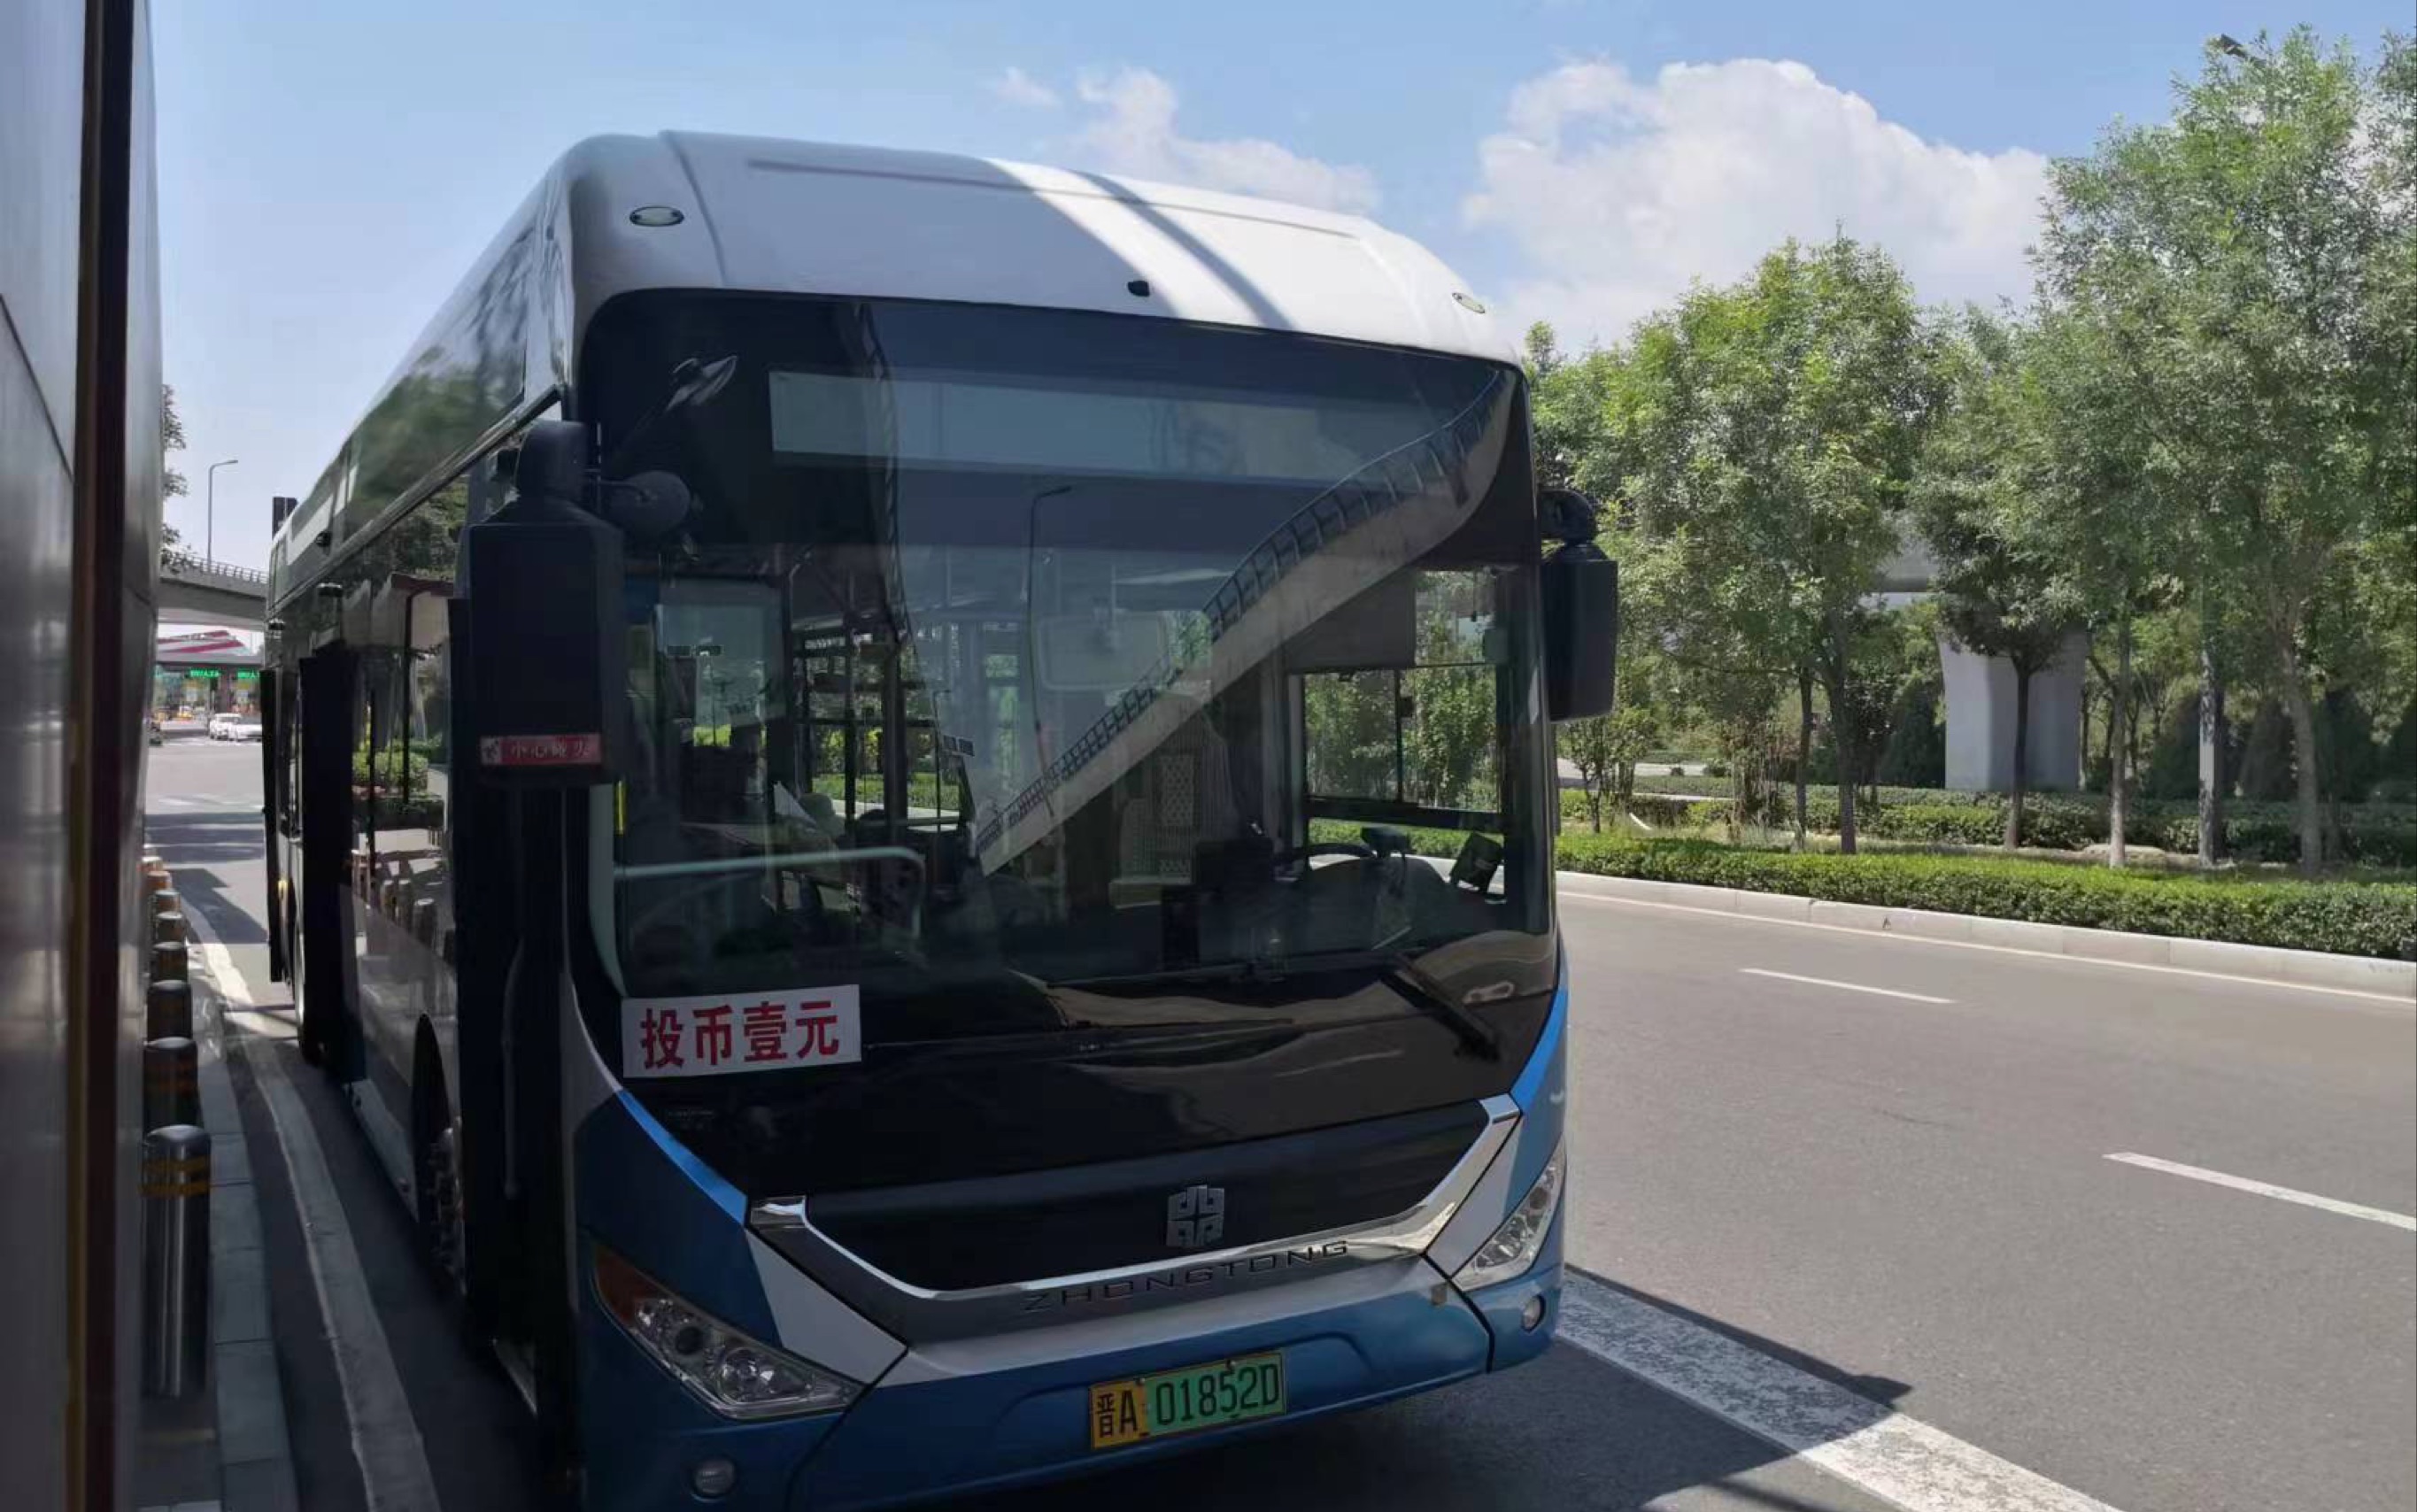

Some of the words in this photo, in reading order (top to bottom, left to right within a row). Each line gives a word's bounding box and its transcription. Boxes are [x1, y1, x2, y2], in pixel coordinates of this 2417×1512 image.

[640, 1001, 839, 1069] 投币壹元
[1023, 1240, 1348, 1312] ZHONGTONG
